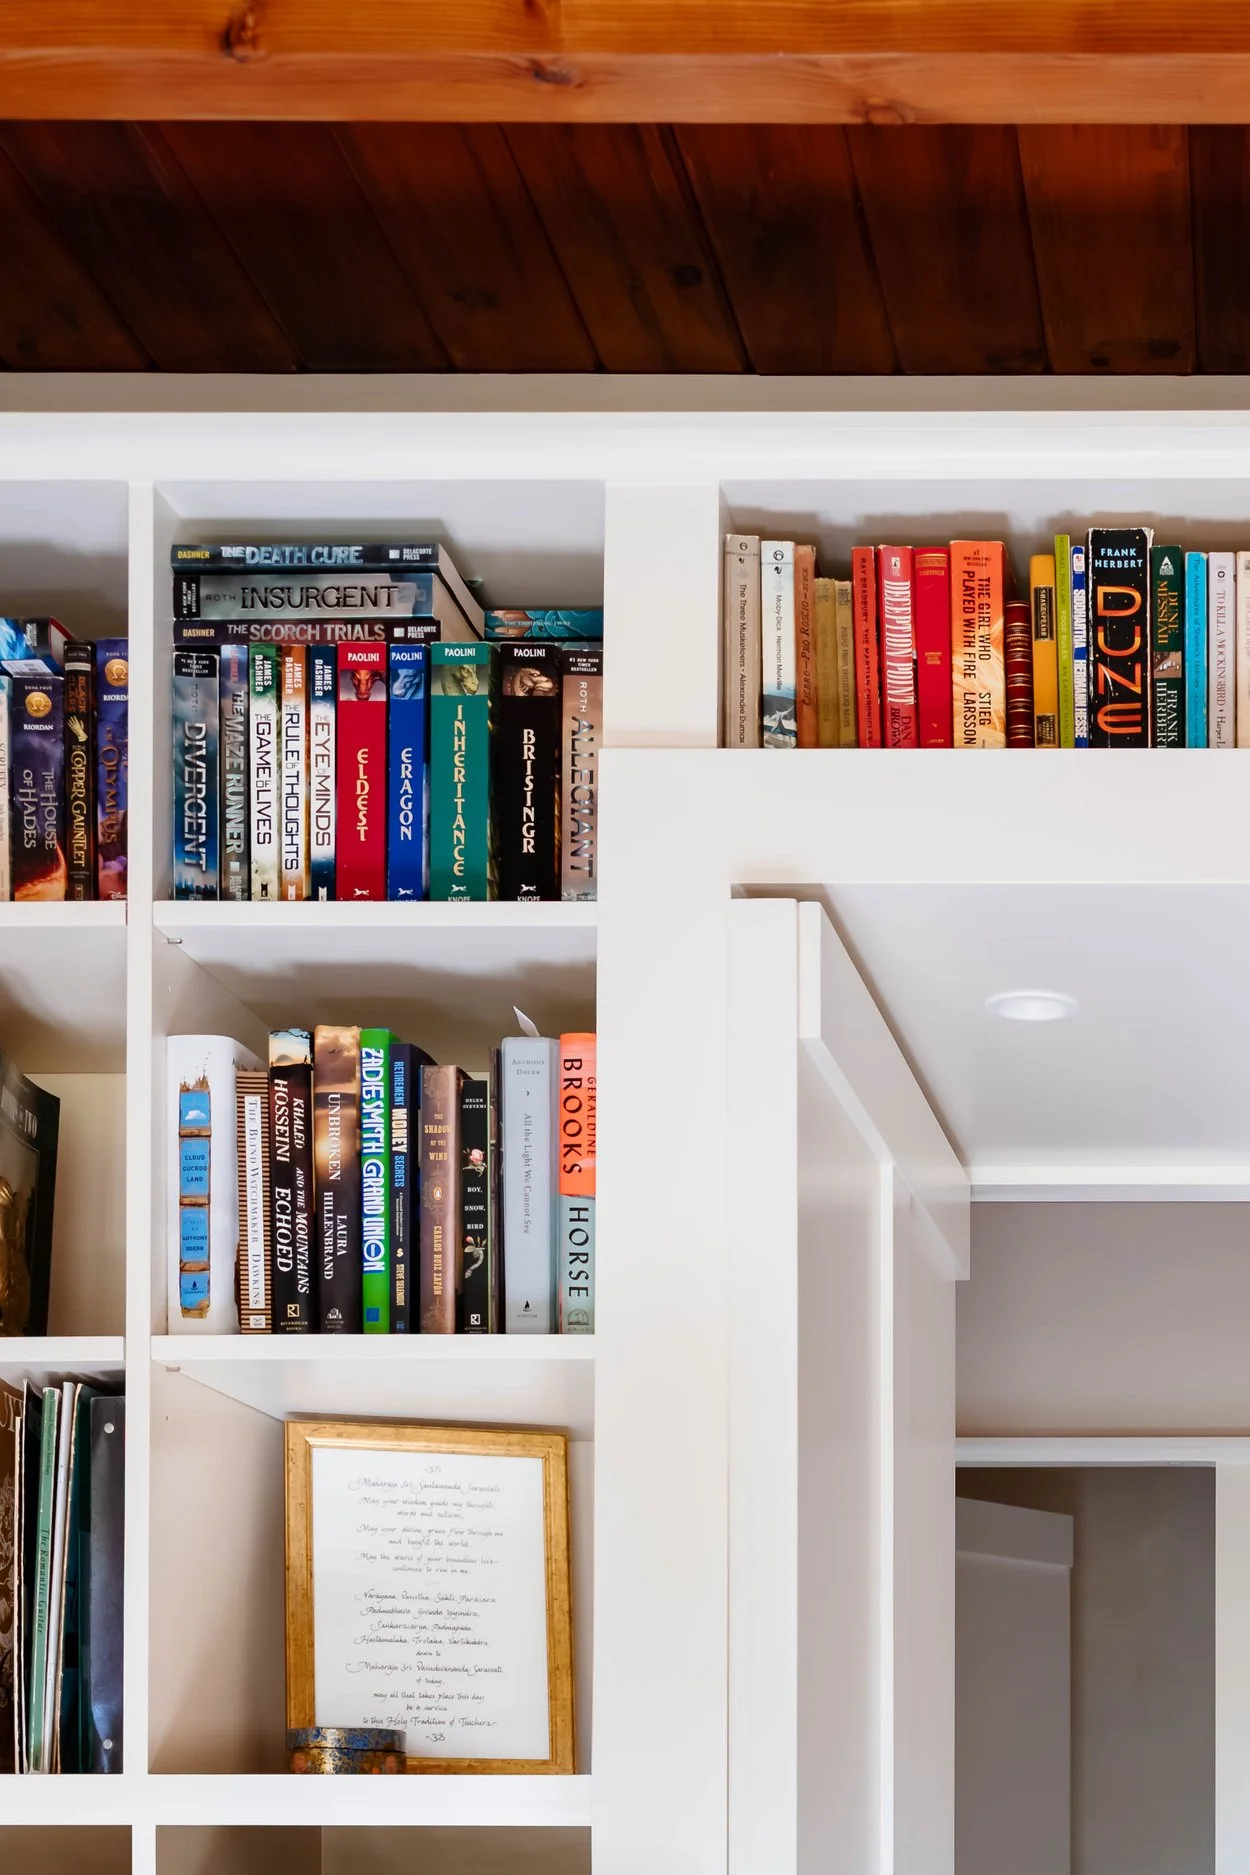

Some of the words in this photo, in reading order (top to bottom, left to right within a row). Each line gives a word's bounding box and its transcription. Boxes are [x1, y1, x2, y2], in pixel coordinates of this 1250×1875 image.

[178, 550, 210, 559] DASHNER
[221, 546, 245, 558] THE
[246, 547, 306, 565] DEATH
[1095, 558, 1143, 568] HERBERT
[1101, 548, 1137, 557] FRANK
[241, 586, 397, 610] INSURGENT
[962, 571, 975, 615] PLAYED
[978, 577, 990, 598] THE
[182, 629, 215, 637] DASHNER
[227, 624, 248, 635] THE
[250, 624, 319, 641] SCORCH
[324, 624, 385, 641] TRIALS
[884, 580, 912, 662] DECEPTION
[964, 618, 975, 648] WITH
[978, 600, 991, 630] GIRL
[348, 652, 380, 662] PAOLINI
[391, 652, 422, 661] PAOLINI
[445, 648, 476, 657] PAOLINI
[514, 648, 545, 657] PAOLINI
[964, 652, 975, 679] FIRE
[978, 634, 991, 661] WHO
[255, 654, 263, 692] DASHNER
[887, 663, 914, 704] POINT
[232, 690, 244, 714] THE
[964, 693, 976, 745] LARSSON
[979, 693, 991, 726] STIEG
[23, 723, 54, 731] RIORDAN
[225, 716, 244, 770] MAZE
[285, 713, 299, 761] RULE
[315, 722, 330, 768] EYE
[256, 722, 272, 778] GAME
[184, 722, 207, 873] DIVERGENT
[315, 775, 331, 846] MINDS
[356, 748, 369, 841] ELDEST
[400, 748, 413, 840] ERAGON
[453, 705, 466, 876] INHERITANCE
[522, 729, 536, 853] BRISINGR
[570, 716, 594, 878] ALLEGIANT
[226, 774, 245, 854] RUNNER
[257, 789, 272, 844] LIVES
[285, 770, 299, 870] THOUGHTS
[273, 1079, 290, 1162] HOSSEINI
[292, 1098, 305, 1150] KHALED
[327, 1093, 341, 1180] UNBROKEN
[392, 1108, 408, 1153] MONEY
[563, 1058, 583, 1175] BROOKS
[276, 1187, 291, 1272] ECHOED
[297, 1210, 310, 1294] MOUNTAINS
[323, 1192, 334, 1280] HILLENBRAND
[336, 1215, 347, 1256] LAURA
[568, 1207, 590, 1298] HORSE
[412, 1717, 445, 1726] Tradition
